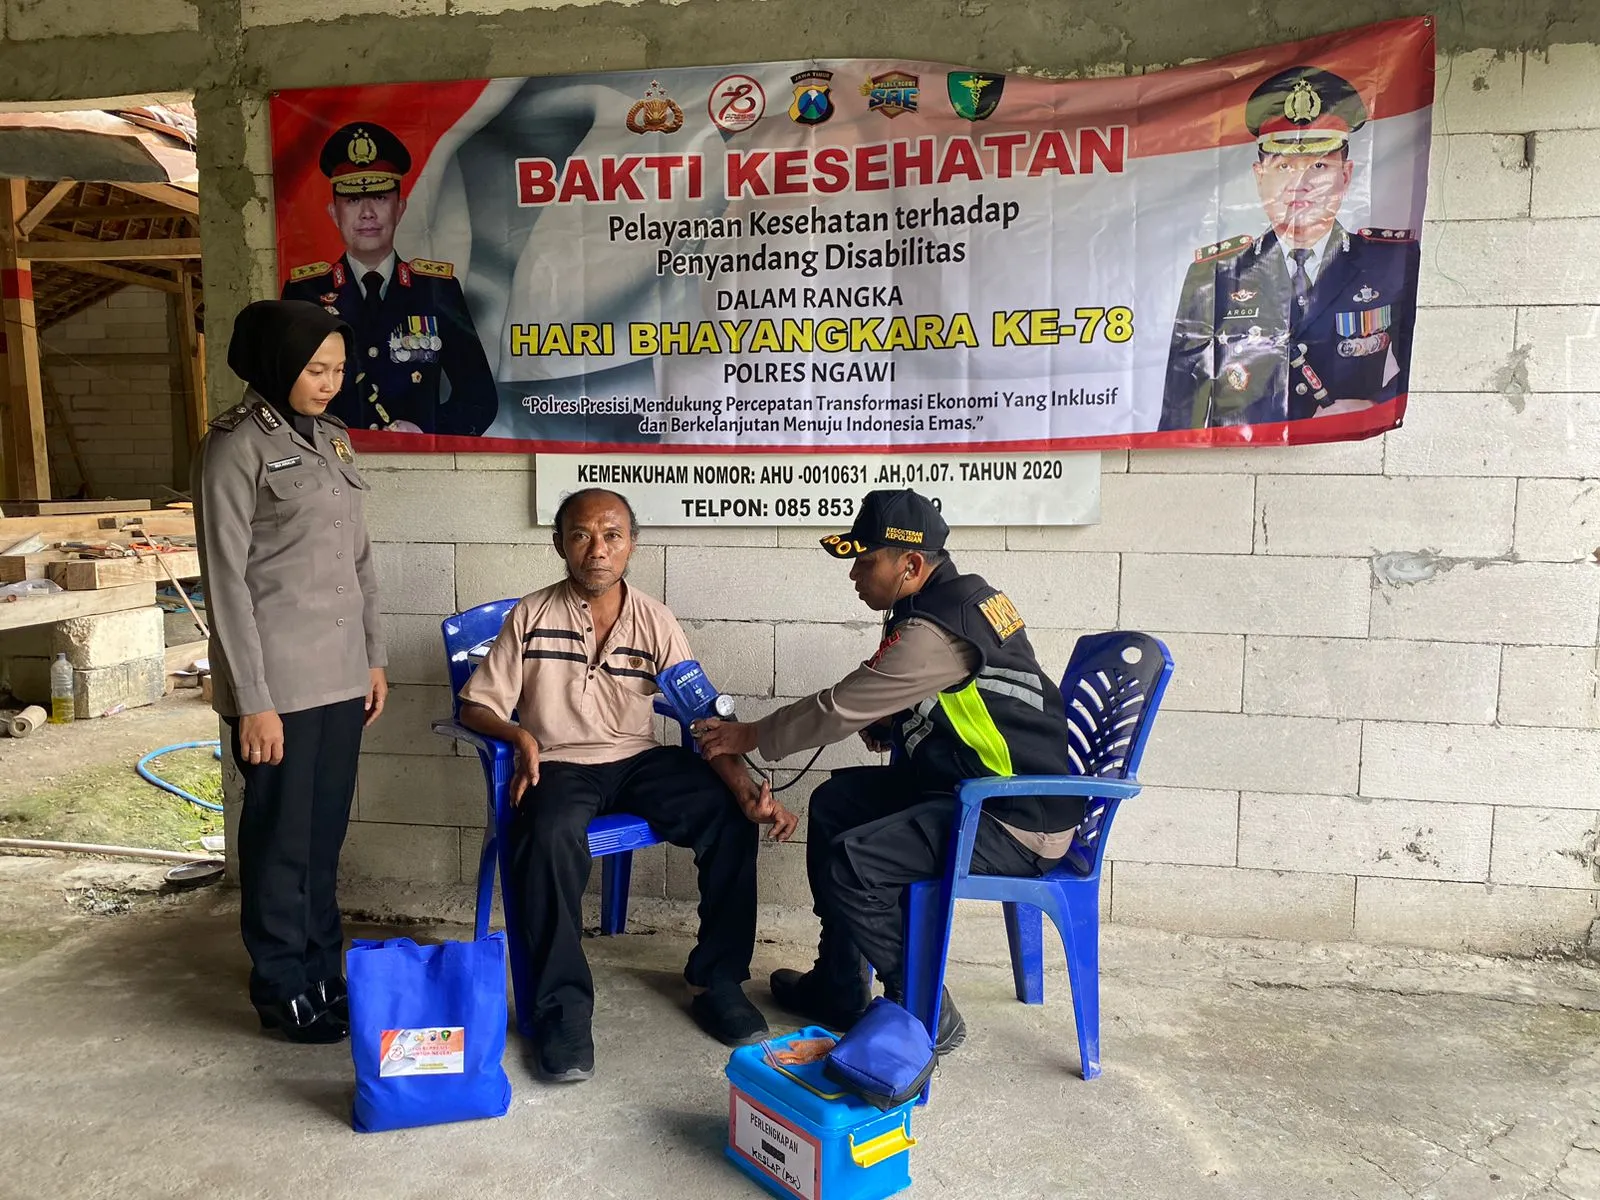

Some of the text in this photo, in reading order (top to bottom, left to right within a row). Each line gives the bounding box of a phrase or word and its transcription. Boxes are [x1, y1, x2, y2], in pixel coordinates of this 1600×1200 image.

[795, 72, 811, 81] JAWA
[517, 125, 1126, 206] BAKTI KESEHATAN
[609, 194, 1020, 247] Pelayanan Kesehatan terhadap
[656, 237, 966, 281] Penyandang Disabilitas
[717, 285, 904, 310] DALAM RANGKA
[510, 305, 1134, 356] HARI BHAYANGKARA KE-78
[724, 361, 896, 383] POLRES NGAWI
[523, 387, 1119, 415] “Polres Presisi Mendukung Percepatan Transformasi Ekonomi Yang Inklusif
[639, 416, 667, 432] dan
[671, 416, 779, 435] Berkelanjutan
[784, 416, 842, 434] Menuju
[847, 415, 924, 431] Indonesia
[577, 464, 688, 484] KEMENKUHAM
[693, 464, 755, 484] NOMOR:
[760, 464, 793, 484] AHU
[798, 464, 868, 484] -0010631
[959, 461, 1017, 481] TAHUN
[1022, 459, 1063, 480] 2020
[682, 499, 768, 517] TELPON:
[775, 498, 811, 517] 085
[817, 498, 854, 517] 853
[885, 532, 923, 544] KEPOLISIAN
[886, 527, 924, 537] KEDOKTERAN
[749, 1112, 799, 1154] PERLENGKAPAN
[751, 1146, 782, 1176] KESLAP
